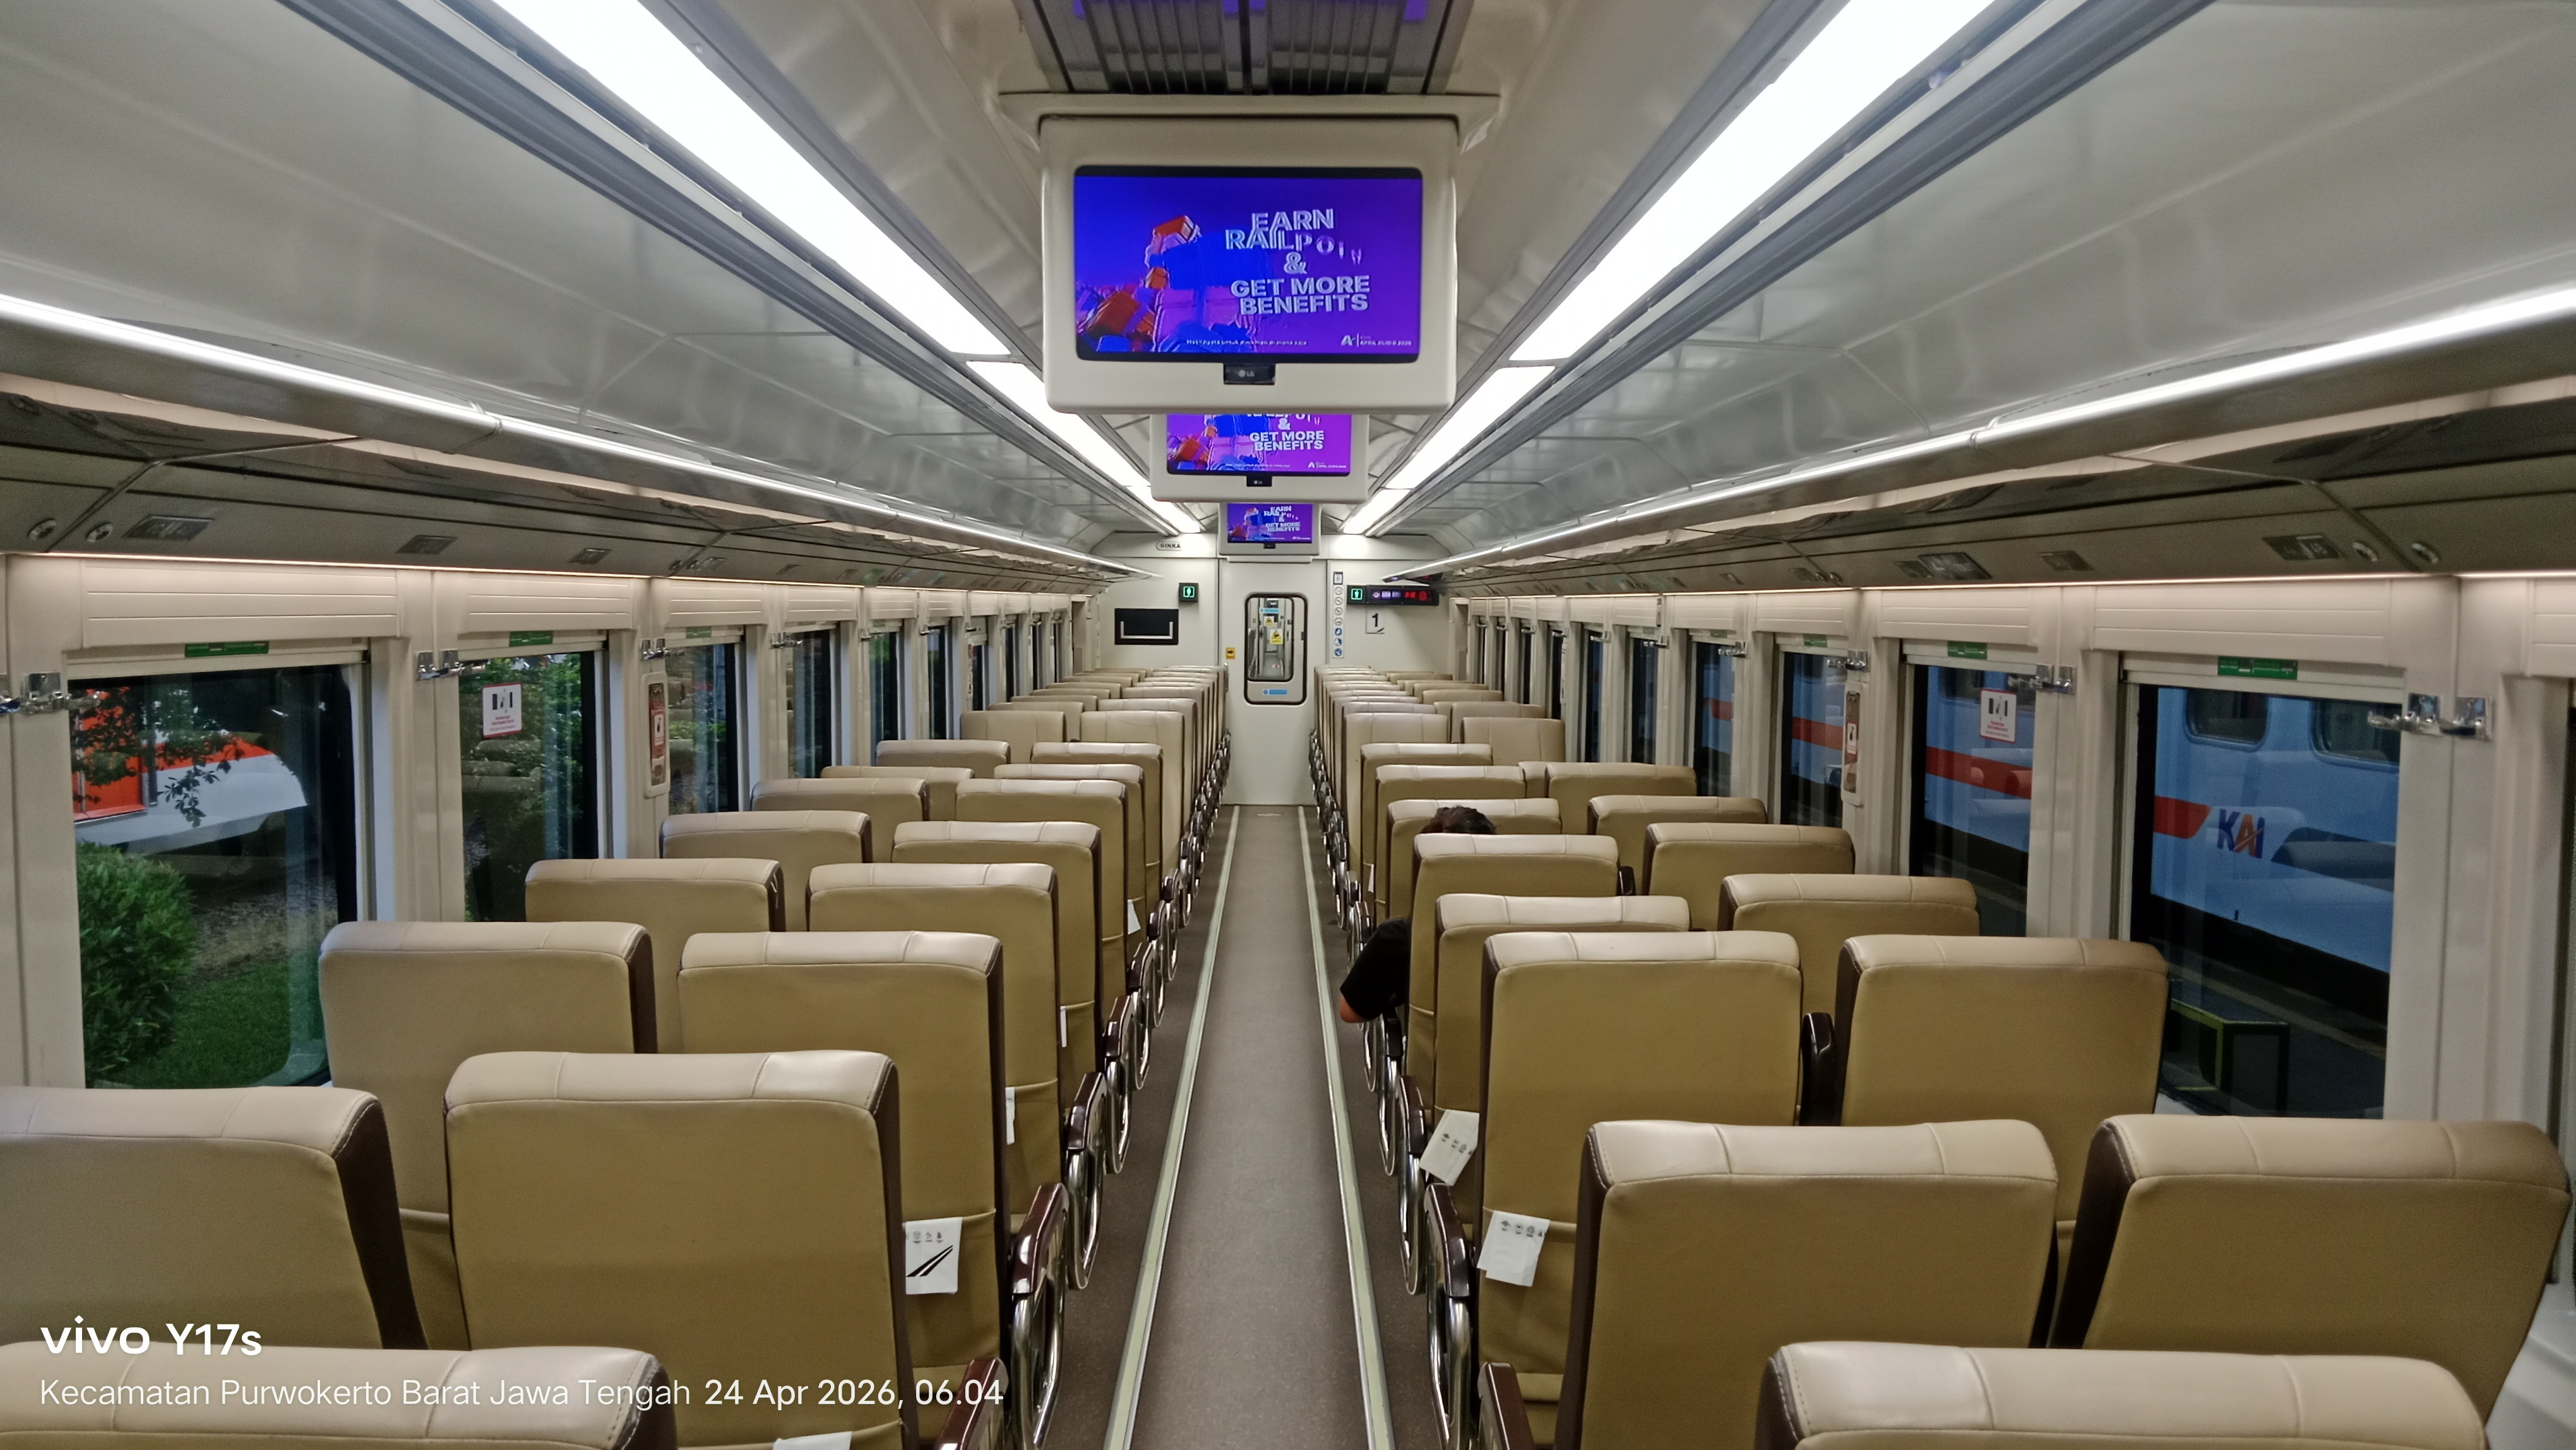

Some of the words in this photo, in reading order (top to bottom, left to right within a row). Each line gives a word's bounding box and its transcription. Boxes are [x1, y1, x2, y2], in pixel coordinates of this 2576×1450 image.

[1251, 208, 1334, 232] EARN
[1284, 251, 1308, 274] &
[1231, 278, 1285, 297] GET
[1291, 275, 1370, 295] MORE
[1240, 293, 1368, 315] BENEFITS
[1278, 417, 1291, 431] &
[1249, 431, 1279, 442] GET
[1282, 430, 1325, 441] MORE
[1254, 440, 1324, 452] BENEFITS
[1372, 613, 1379, 627] 1
[2217, 808, 2265, 859] KAI
